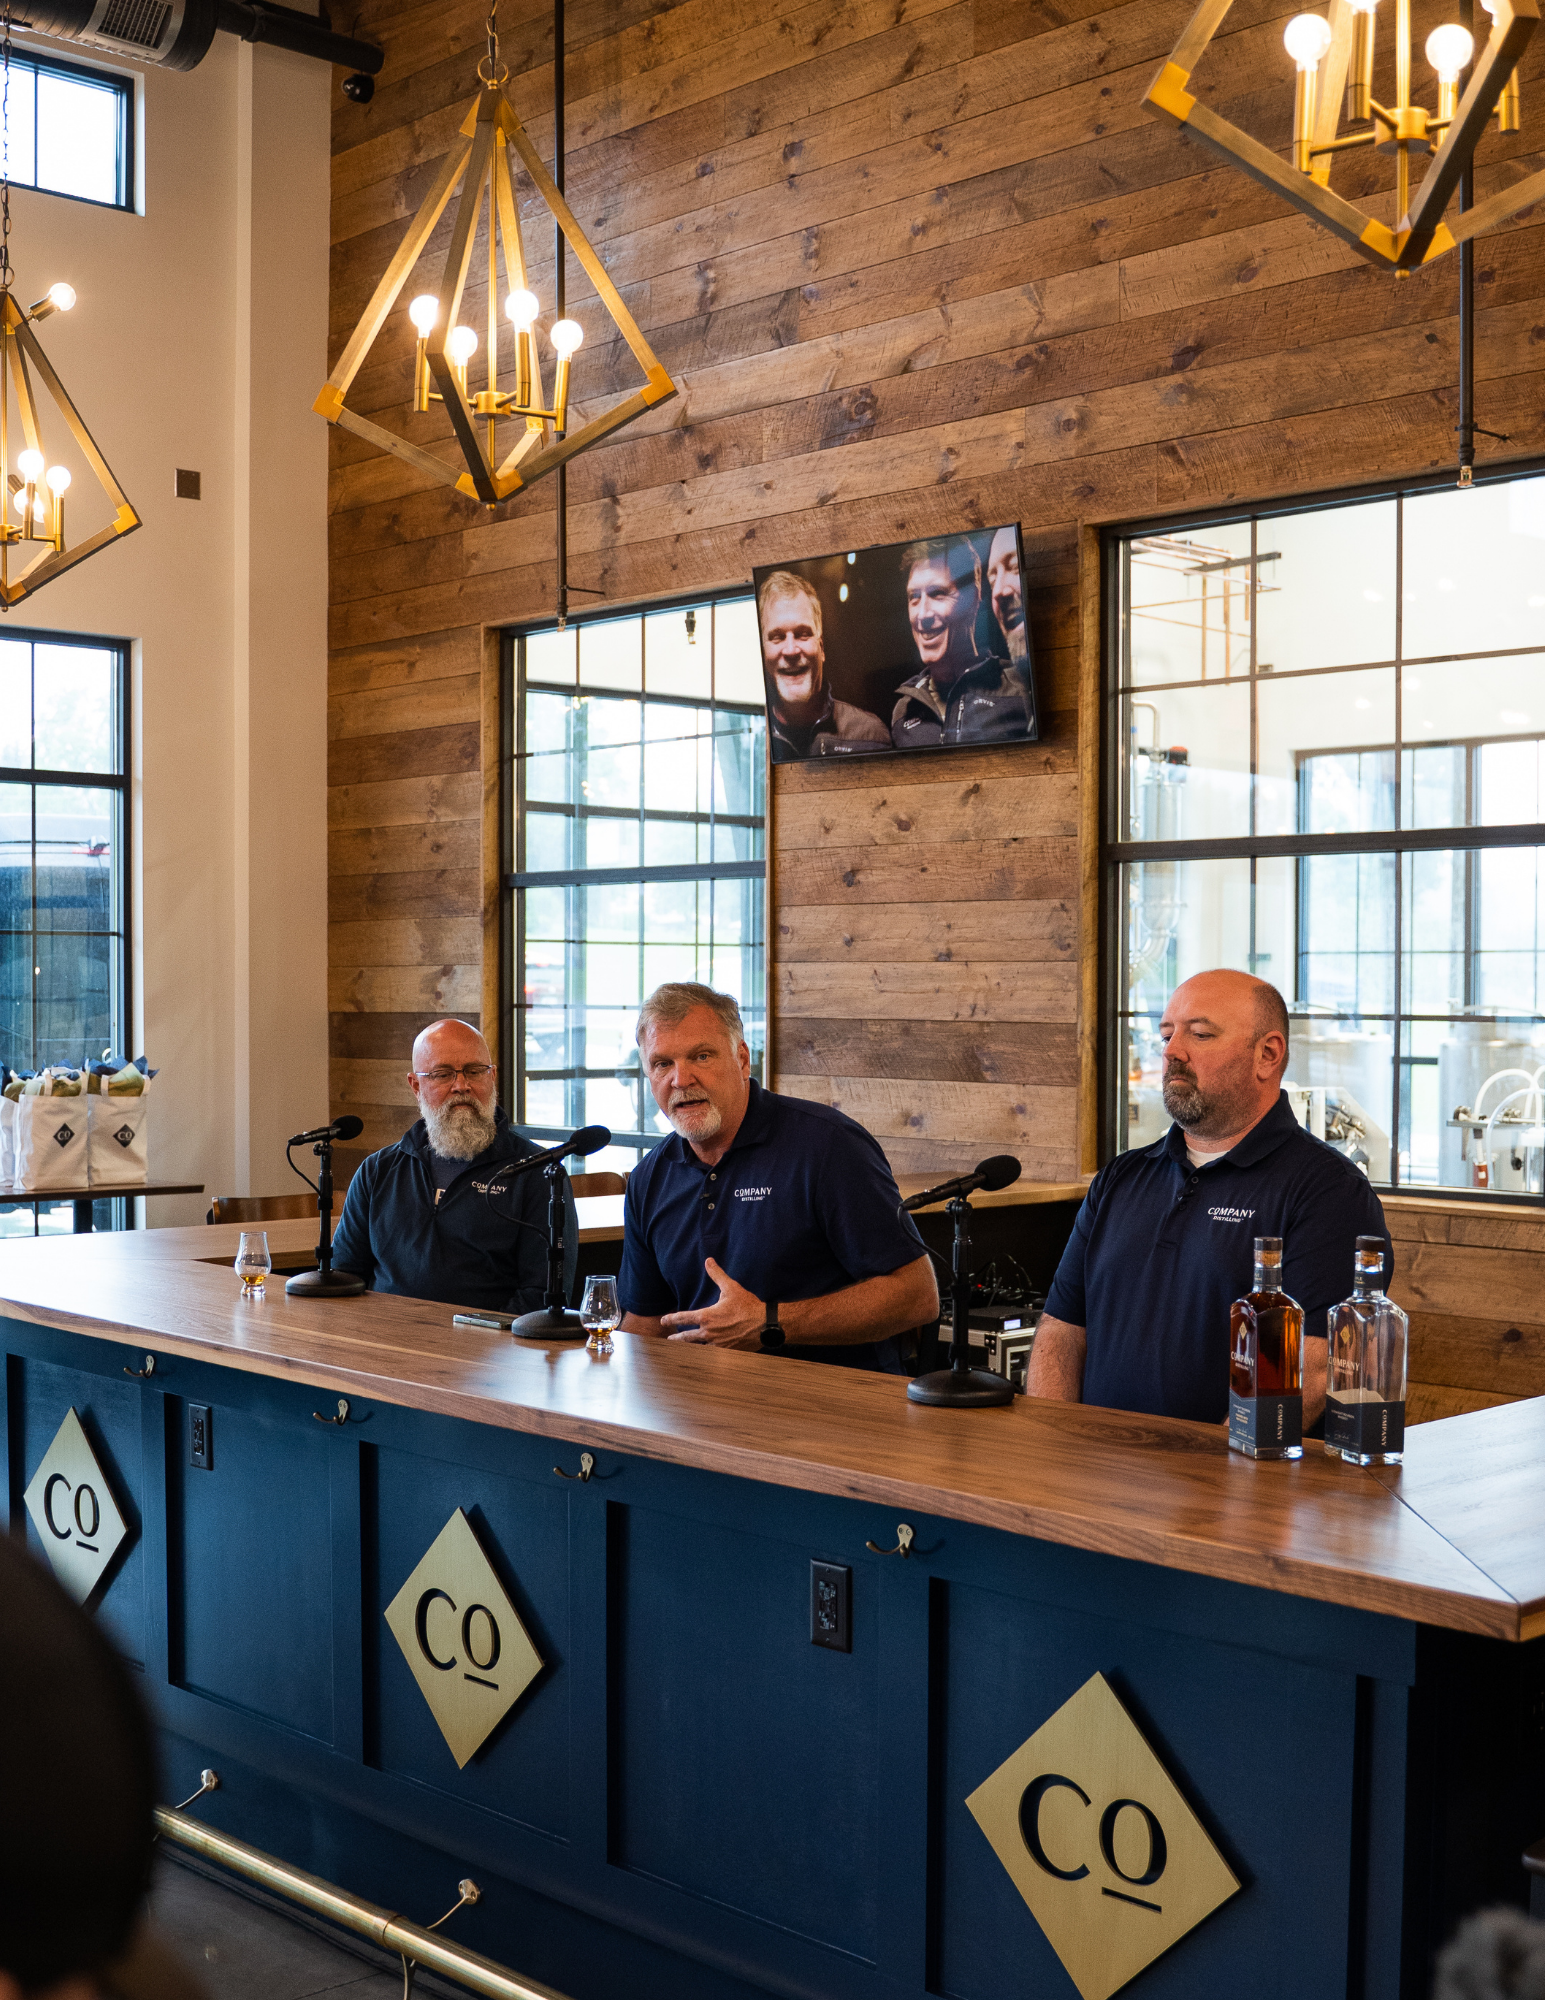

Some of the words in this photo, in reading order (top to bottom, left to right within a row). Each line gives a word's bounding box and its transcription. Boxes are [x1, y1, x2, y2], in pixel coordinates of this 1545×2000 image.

[471, 1181, 508, 1193] COMANY
[734, 1187, 772, 1197] COMPANY
[1207, 1207, 1255, 1218] COMPANY
[1328, 1356, 1360, 1371] COMPANY
[1276, 1404, 1284, 1440] COMPANY
